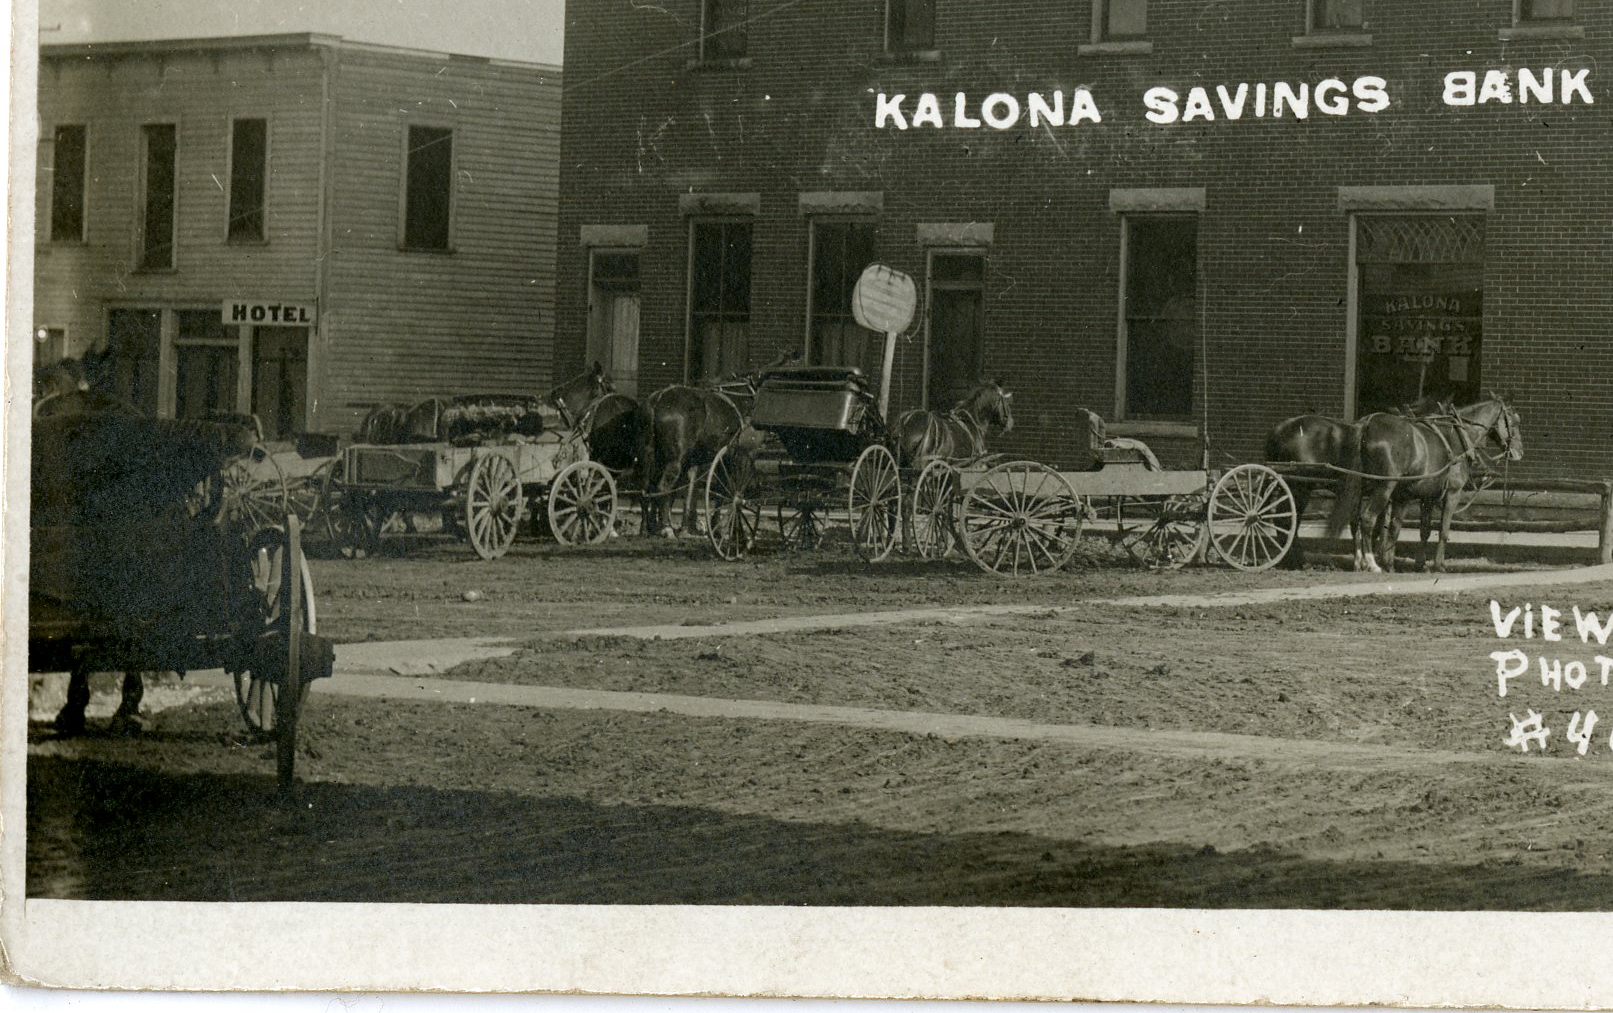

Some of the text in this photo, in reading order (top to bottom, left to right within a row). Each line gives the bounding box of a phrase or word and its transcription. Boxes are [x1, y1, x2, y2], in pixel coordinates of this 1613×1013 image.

[232, 303, 310, 322] HOTEL
[1386, 295, 1460, 313] KALONA
[1382, 319, 1464, 331] SAVINGS
[1372, 336, 1472, 353] BANK
